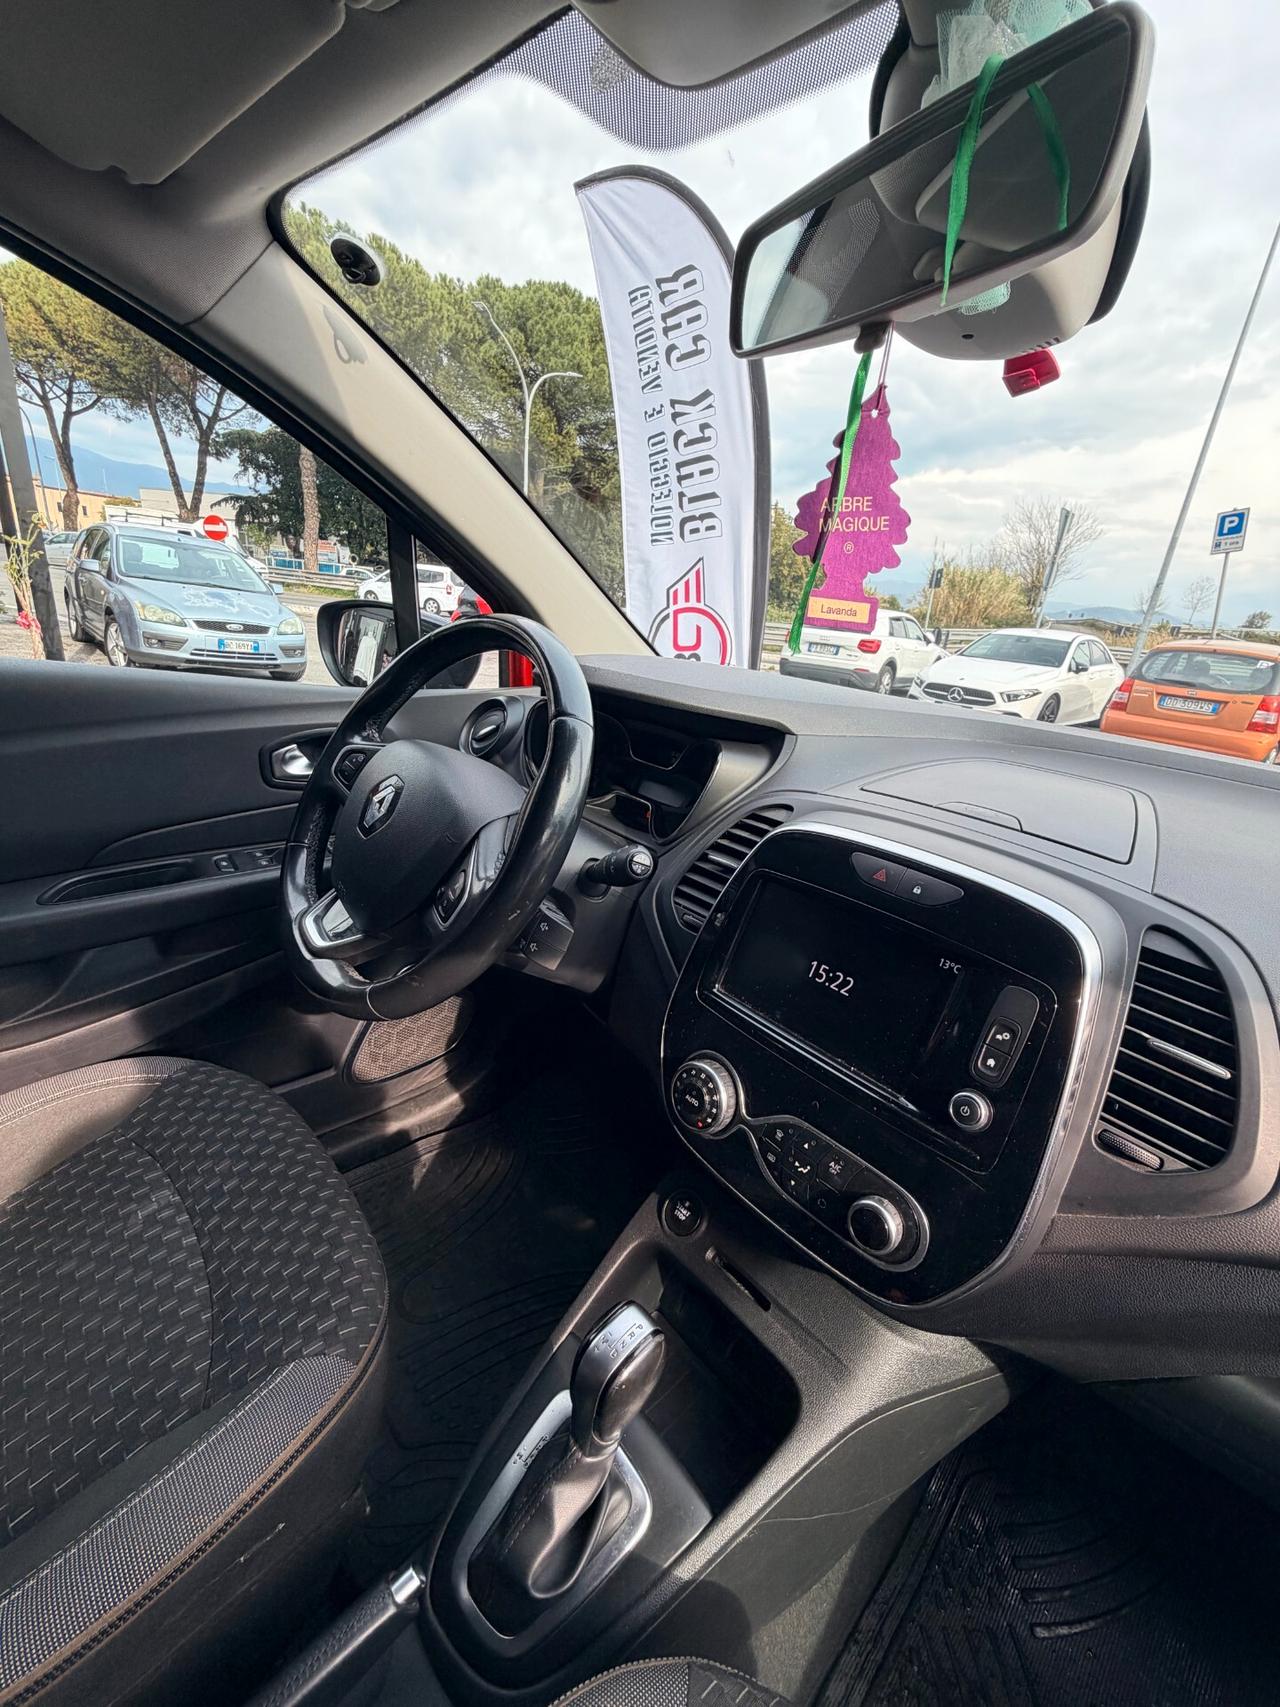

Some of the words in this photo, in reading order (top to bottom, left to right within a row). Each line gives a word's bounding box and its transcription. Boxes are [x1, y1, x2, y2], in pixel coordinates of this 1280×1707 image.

[820, 496, 873, 513] ARBRE
[819, 516, 890, 532] MAGIQUE
[1222, 516, 1240, 534] P
[820, 604, 858, 617] Lavanda
[939, 958, 962, 974] 13°C
[808, 961, 854, 997] 15:22
[685, 1094, 699, 1107] AUTO
